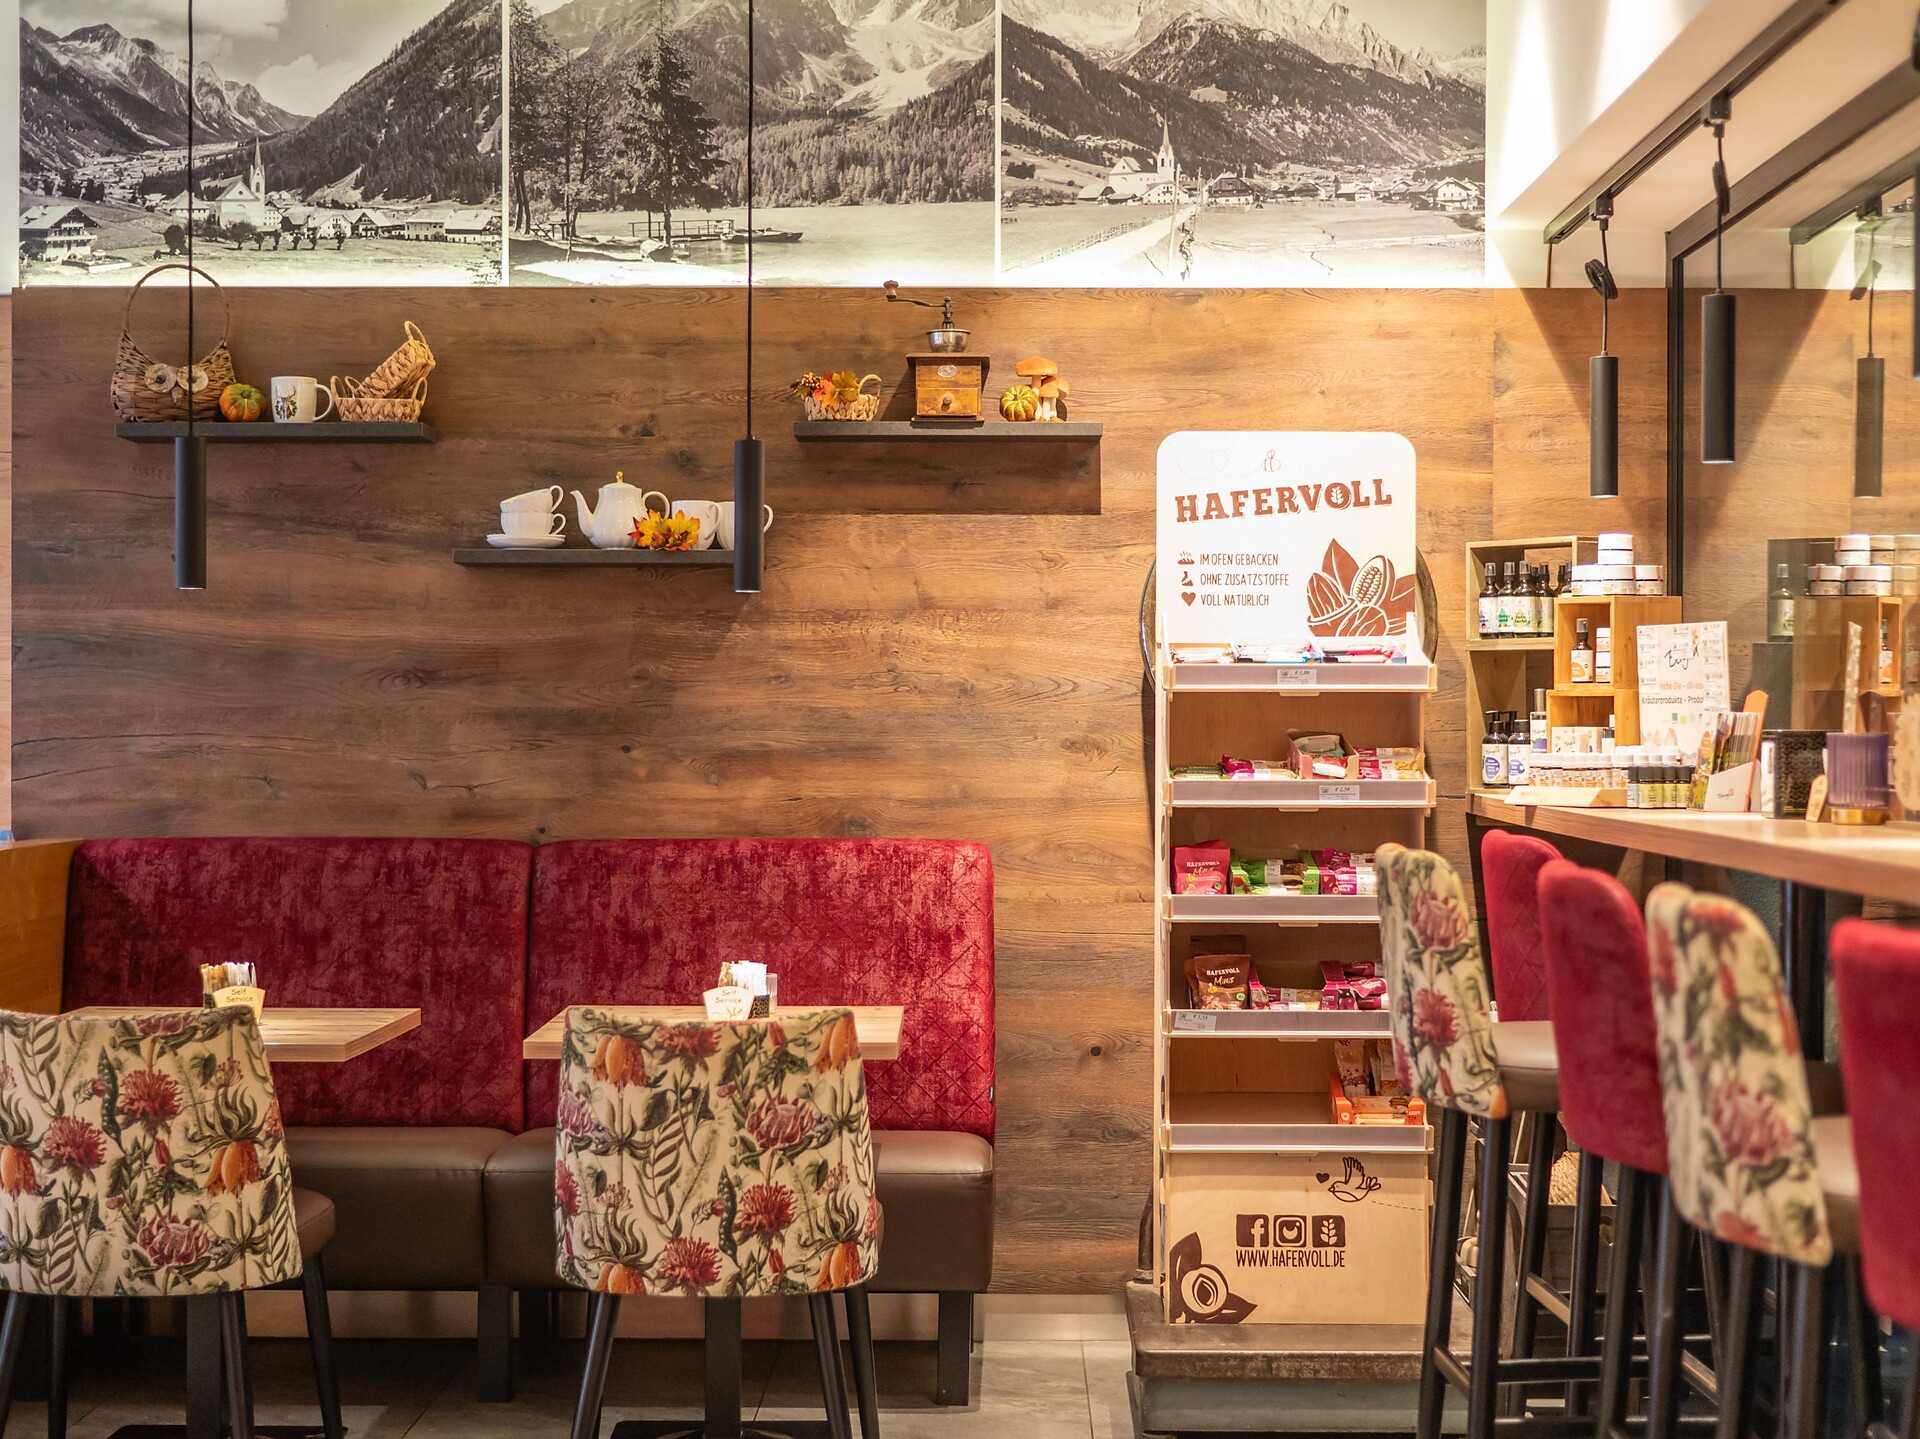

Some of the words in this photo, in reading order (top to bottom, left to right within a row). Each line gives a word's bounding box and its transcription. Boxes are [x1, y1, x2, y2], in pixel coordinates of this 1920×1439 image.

[1174, 478, 1393, 523] HAFERVOLL
[1200, 553, 1210, 566] IM
[1211, 553, 1234, 566] OFEN
[1235, 553, 1279, 566] GEBACKEN
[1200, 573, 1222, 586] OHNE
[1224, 573, 1290, 586] ZUSATZSTOFFE
[1201, 594, 1222, 606] VOLL
[1223, 591, 1270, 607] NATÜRLICH
[1206, 967, 1240, 976] HAFERVOLL
[1213, 975, 1235, 986] Minis
[1235, 1249, 1346, 1268] WWW.HAFERVOLL.DE
